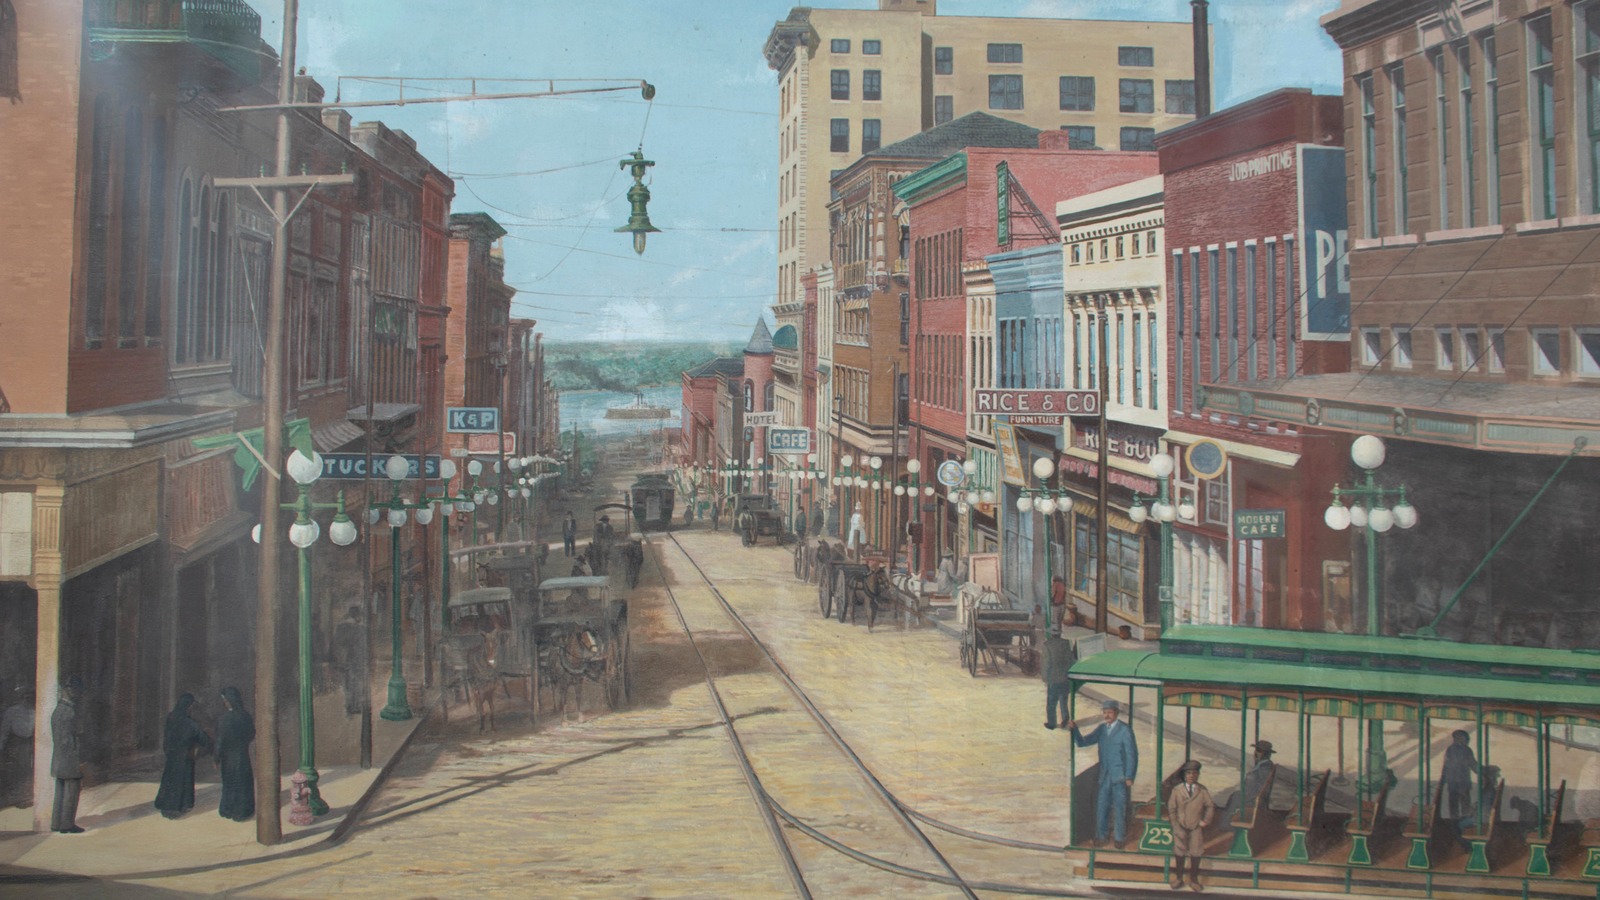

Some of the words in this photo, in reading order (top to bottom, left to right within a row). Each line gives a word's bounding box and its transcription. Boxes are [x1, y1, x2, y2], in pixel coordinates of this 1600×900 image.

[1229, 162, 1248, 181] JOB
[1248, 150, 1292, 177] PRINTING
[978, 393, 1030, 411] RICE
[1042, 394, 1054, 411] &
[1066, 393, 1096, 412] CO
[746, 415, 778, 425] HOTEL
[1010, 415, 1060, 425] FURNITURE
[773, 433, 806, 447] CAFE
[1085, 428, 1119, 453] RIE
[324, 459, 435, 475] TUCKRS
[1238, 515, 1279, 524] MODERN
[1241, 523, 1278, 535] CAFE
[1148, 827, 1173, 845] 23
